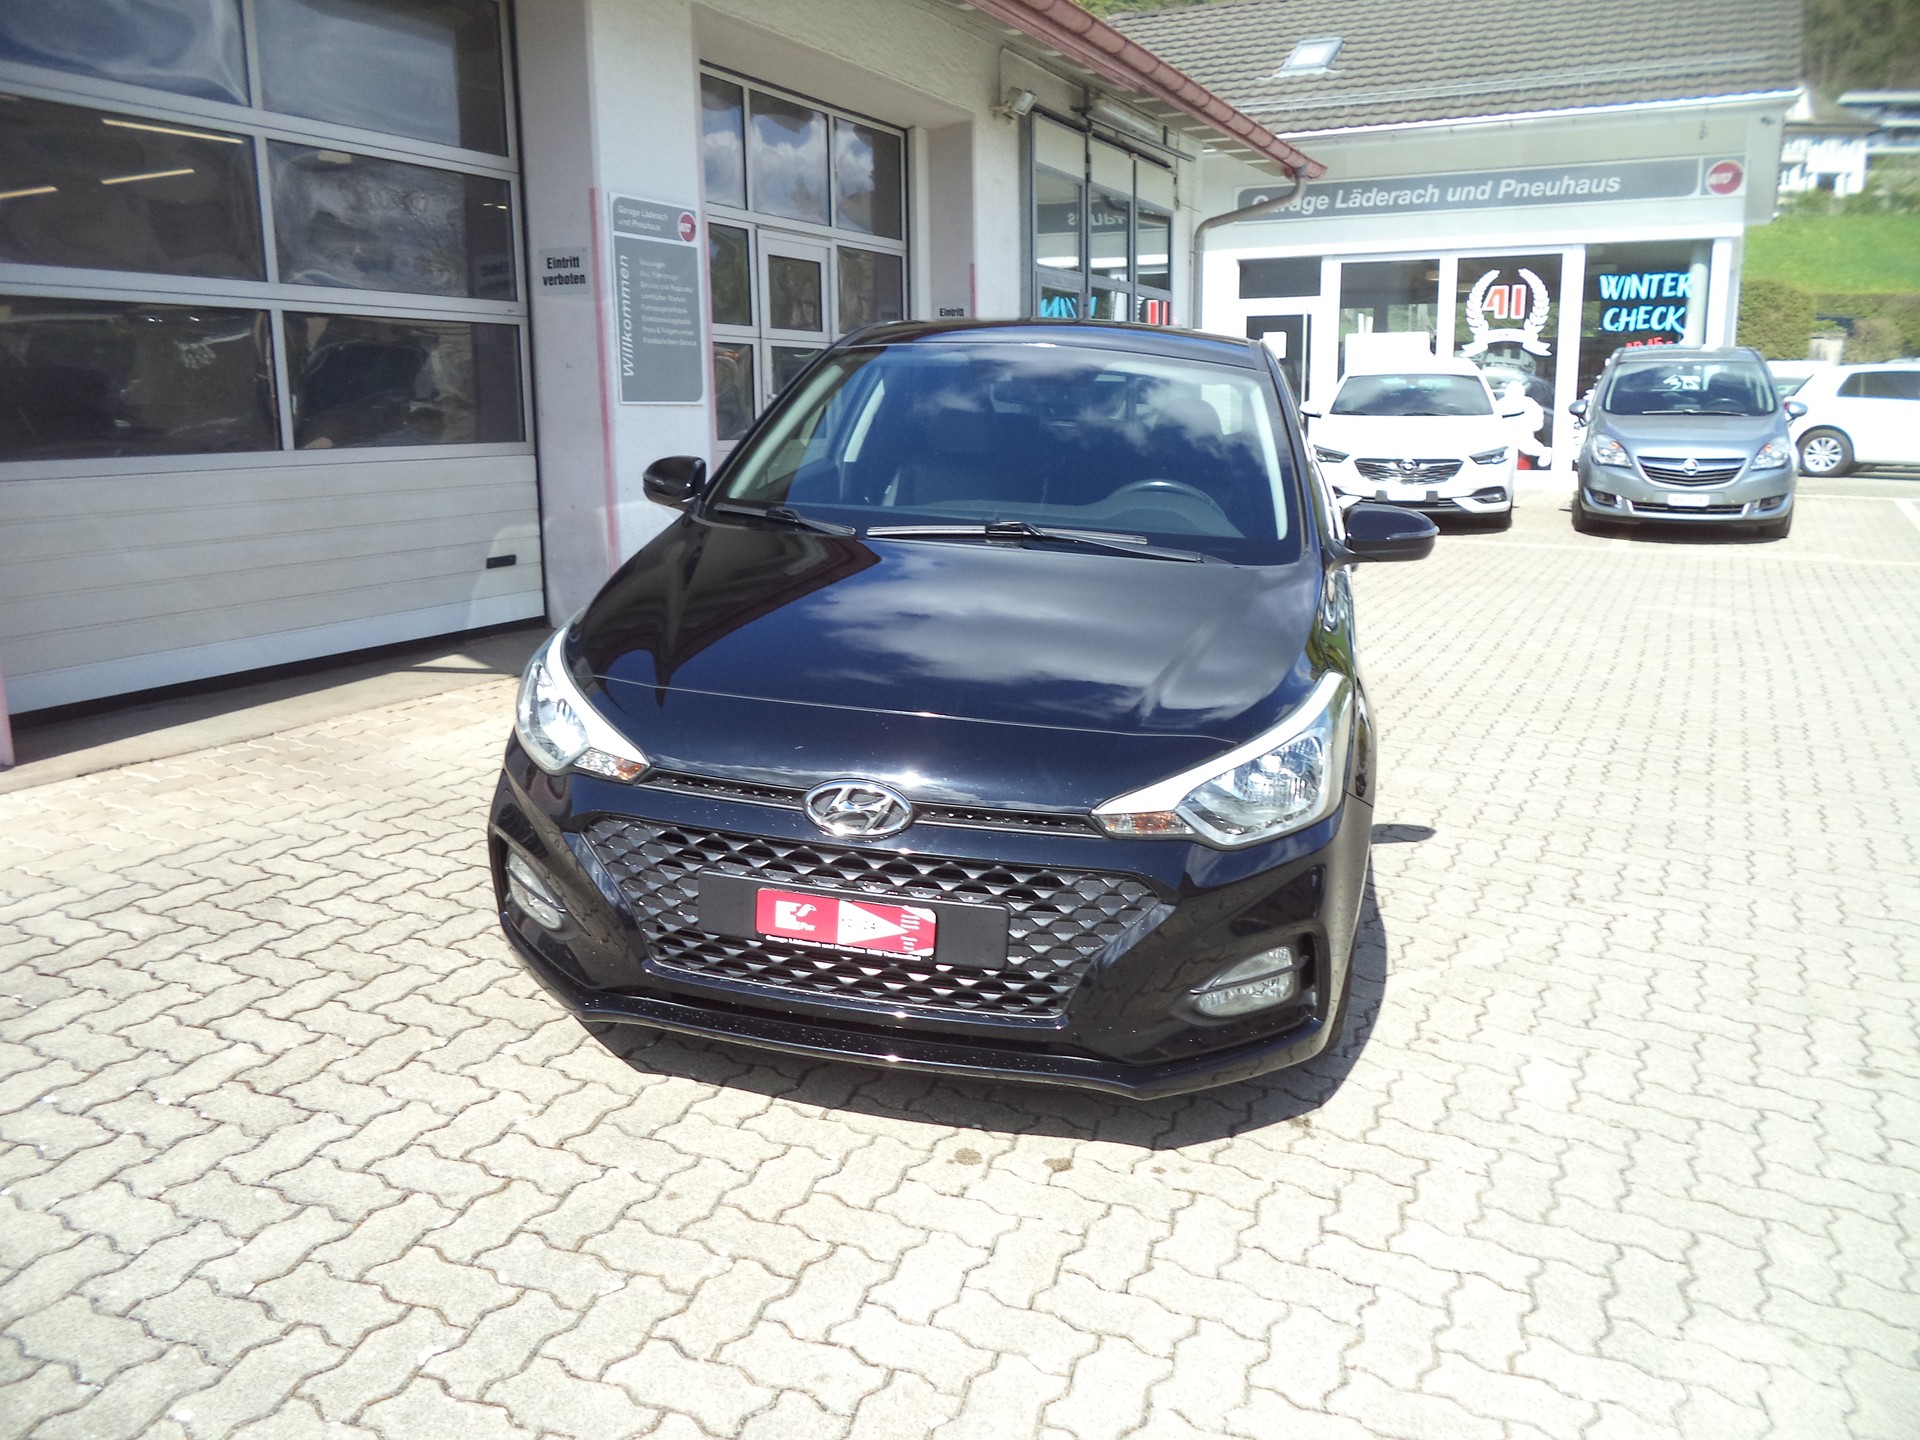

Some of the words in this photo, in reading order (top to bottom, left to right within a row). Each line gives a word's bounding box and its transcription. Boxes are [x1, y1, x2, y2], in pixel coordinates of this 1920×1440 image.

[1252, 194, 1330, 215] Gage
[1335, 184, 1440, 209] Läderach
[1447, 180, 1494, 202] und
[1498, 175, 1621, 199] Pneuhaus
[547, 256, 580, 269] Eintritt
[543, 273, 586, 286] verboten
[1599, 272, 1694, 300] WINTER
[620, 254, 635, 376] Willkommen
[1602, 305, 1687, 333] CHECK
